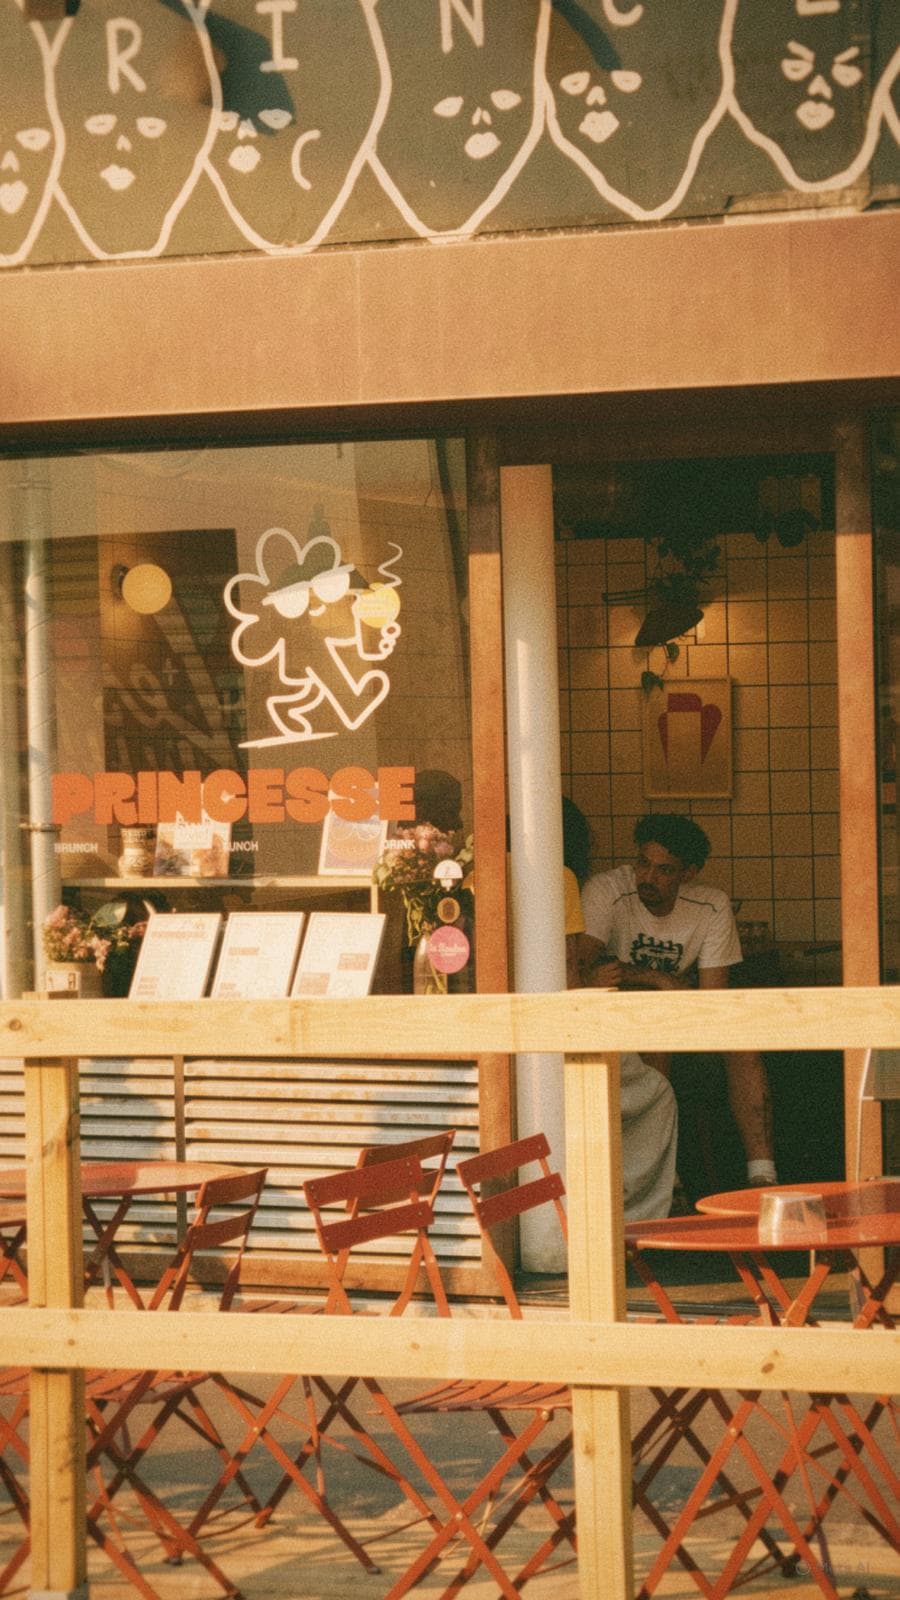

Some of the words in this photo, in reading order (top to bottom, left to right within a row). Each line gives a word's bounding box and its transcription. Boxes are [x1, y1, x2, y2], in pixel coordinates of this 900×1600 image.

[106, 17, 147, 94] R
[52, 766, 416, 825] PRINCESSE
[54, 842, 99, 853] BRUNCH
[224, 840, 259, 852] UNCH
[383, 839, 416, 850] DRINK
